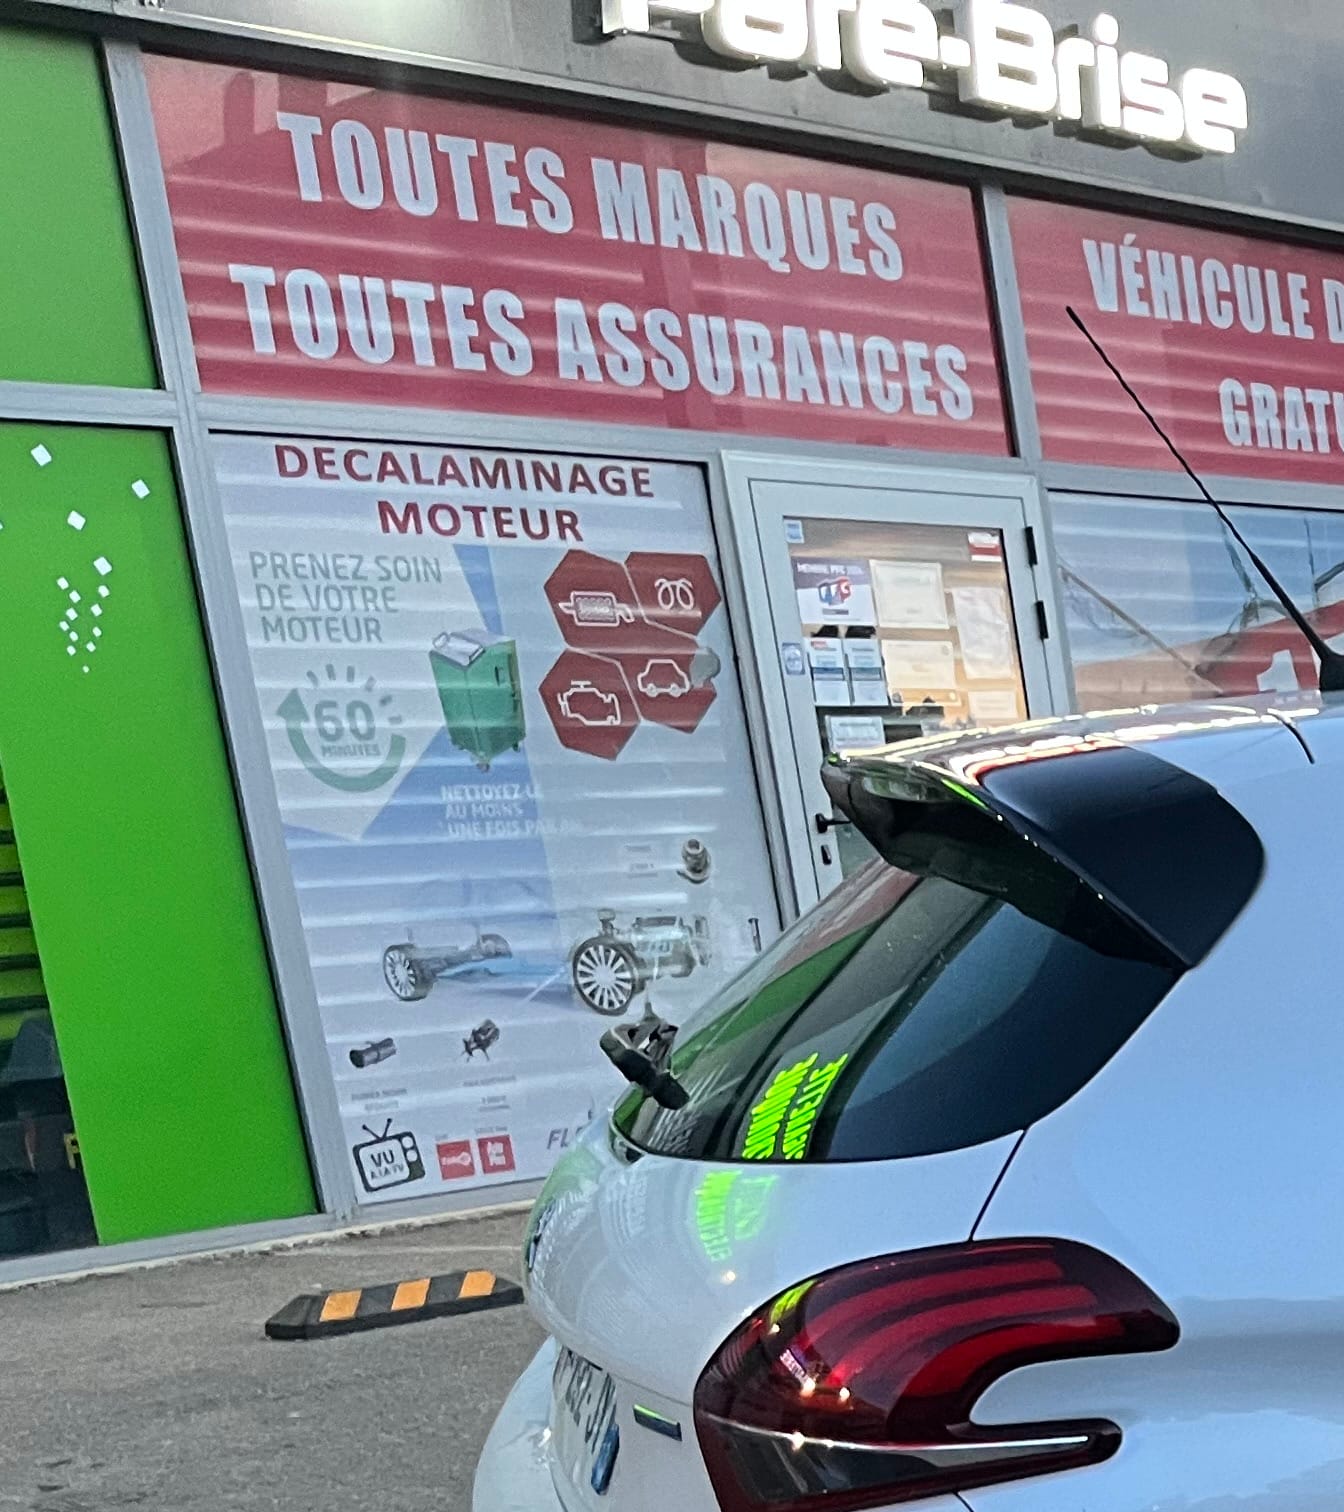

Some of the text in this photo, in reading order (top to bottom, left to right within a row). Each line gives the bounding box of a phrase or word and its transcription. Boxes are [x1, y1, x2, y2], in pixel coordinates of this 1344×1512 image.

[277, 111, 904, 282] TOUTES MARQUES
[1082, 233, 1314, 340] VÉHICULE
[227, 263, 974, 421] TOUTES ASSURANCES
[273, 443, 655, 498] DECALAMINAGE
[376, 500, 584, 542] MOTEUR
[249, 551, 442, 583] PRENEZ SOIN
[256, 583, 399, 613] DE VOTRE
[261, 615, 383, 643] MOTEUR
[314, 700, 376, 742] 60
[445, 803, 467, 819] AU
[371, 1150, 394, 1167] VU
